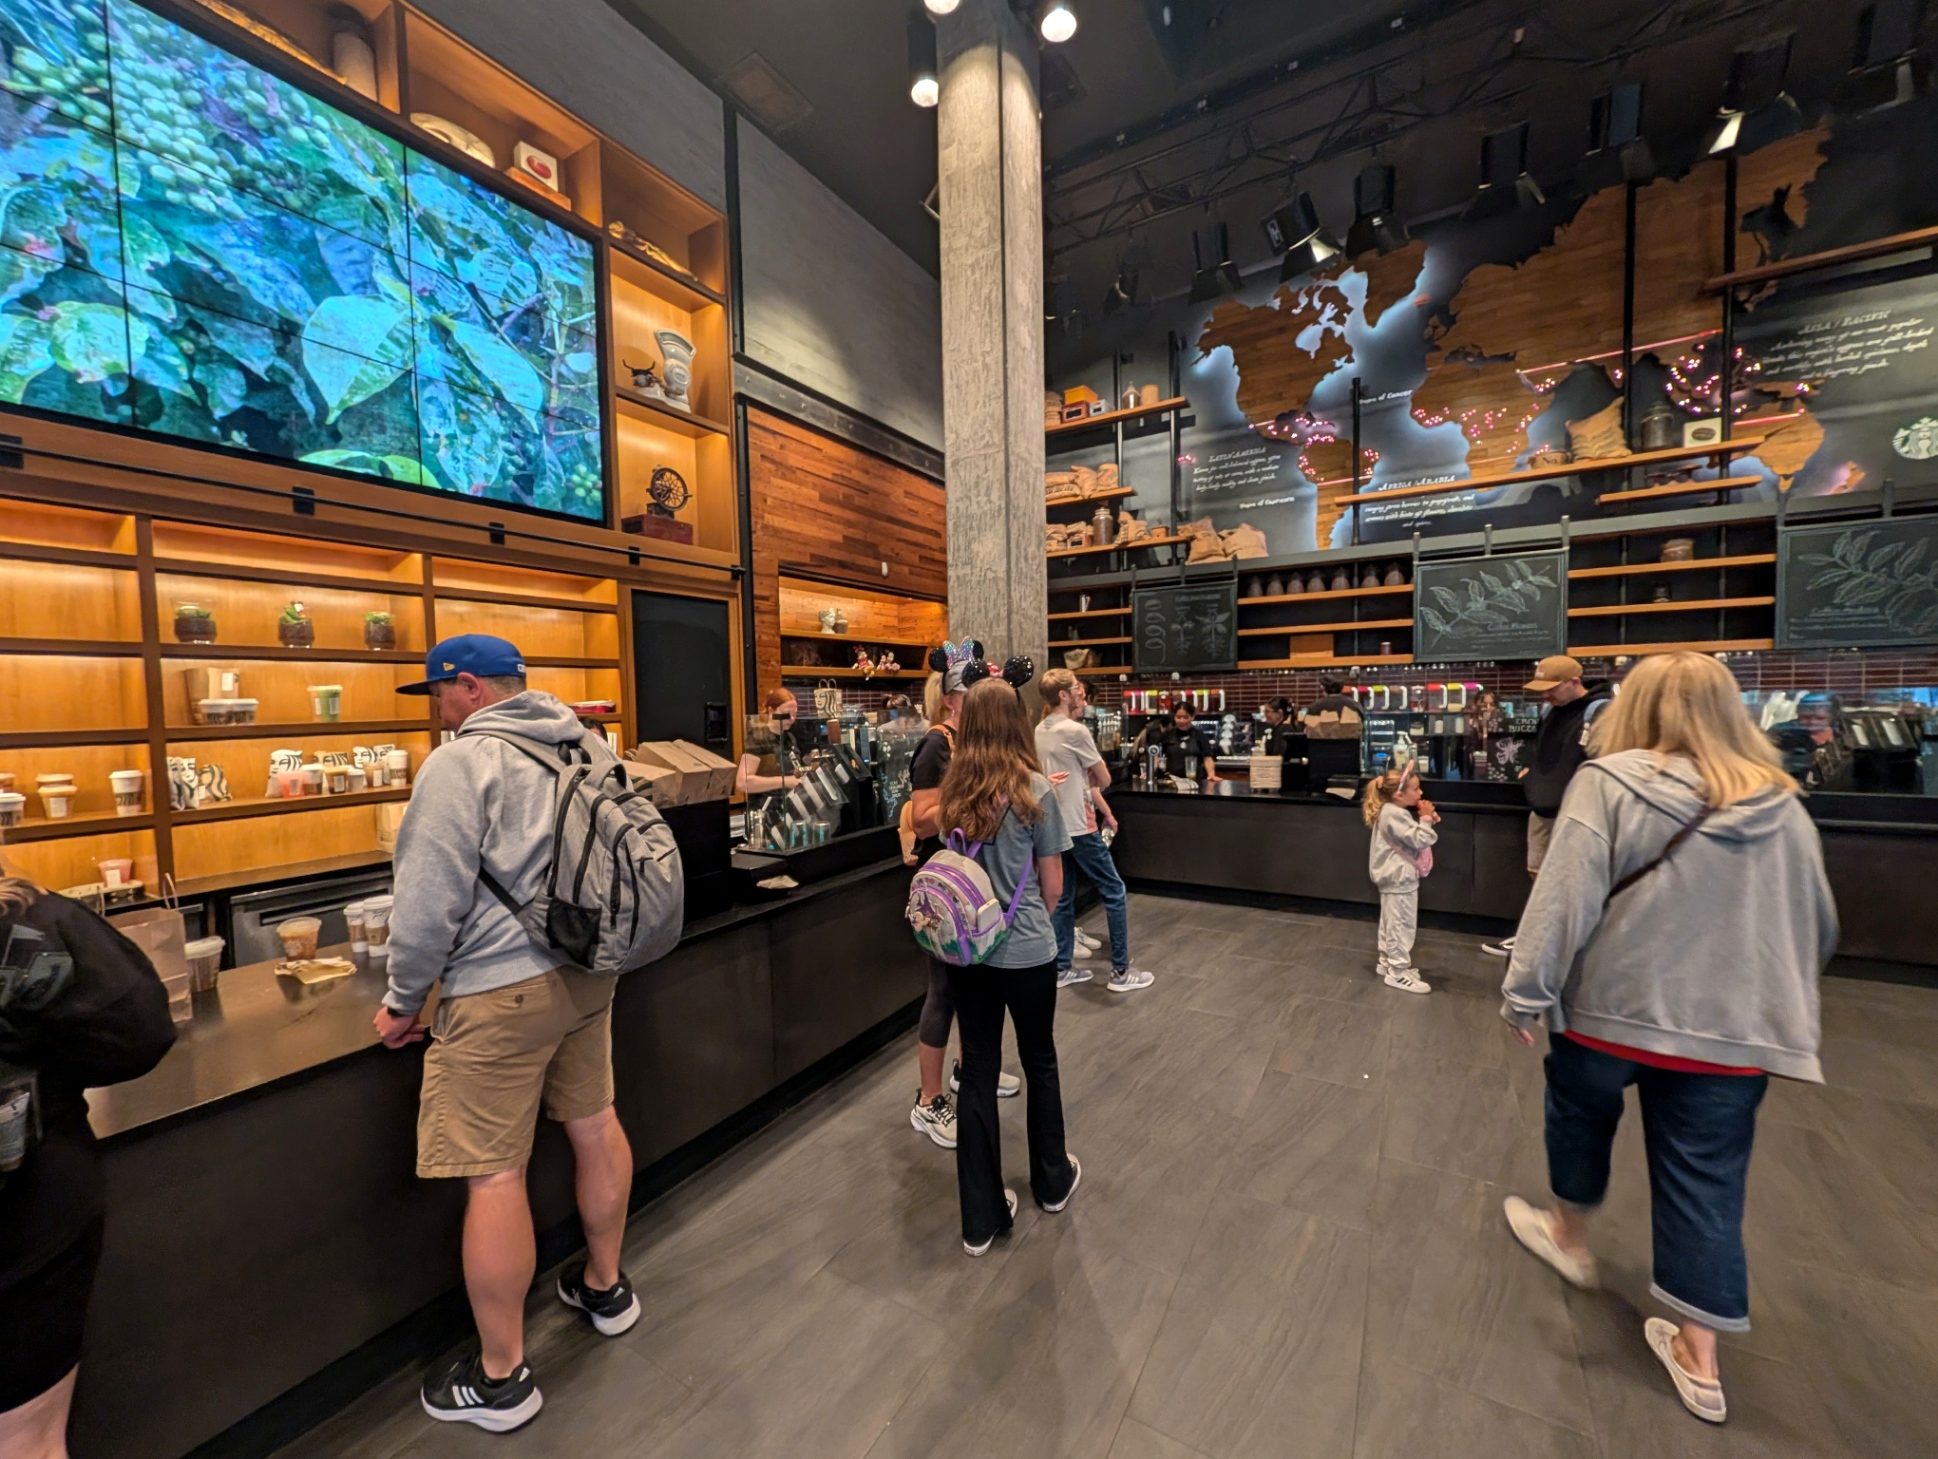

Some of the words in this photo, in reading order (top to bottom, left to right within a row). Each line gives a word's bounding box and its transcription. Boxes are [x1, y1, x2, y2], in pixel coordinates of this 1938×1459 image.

[1798, 321, 1831, 335] ASIA
[1841, 309, 1892, 327] PACIFIC
[1387, 389, 1414, 399] Cancer
[1208, 450, 1235, 463] LATIN
[1233, 446, 1267, 459] AMERICA
[1378, 481, 1411, 491] AFRICA
[1416, 475, 1455, 486] ARABIA
